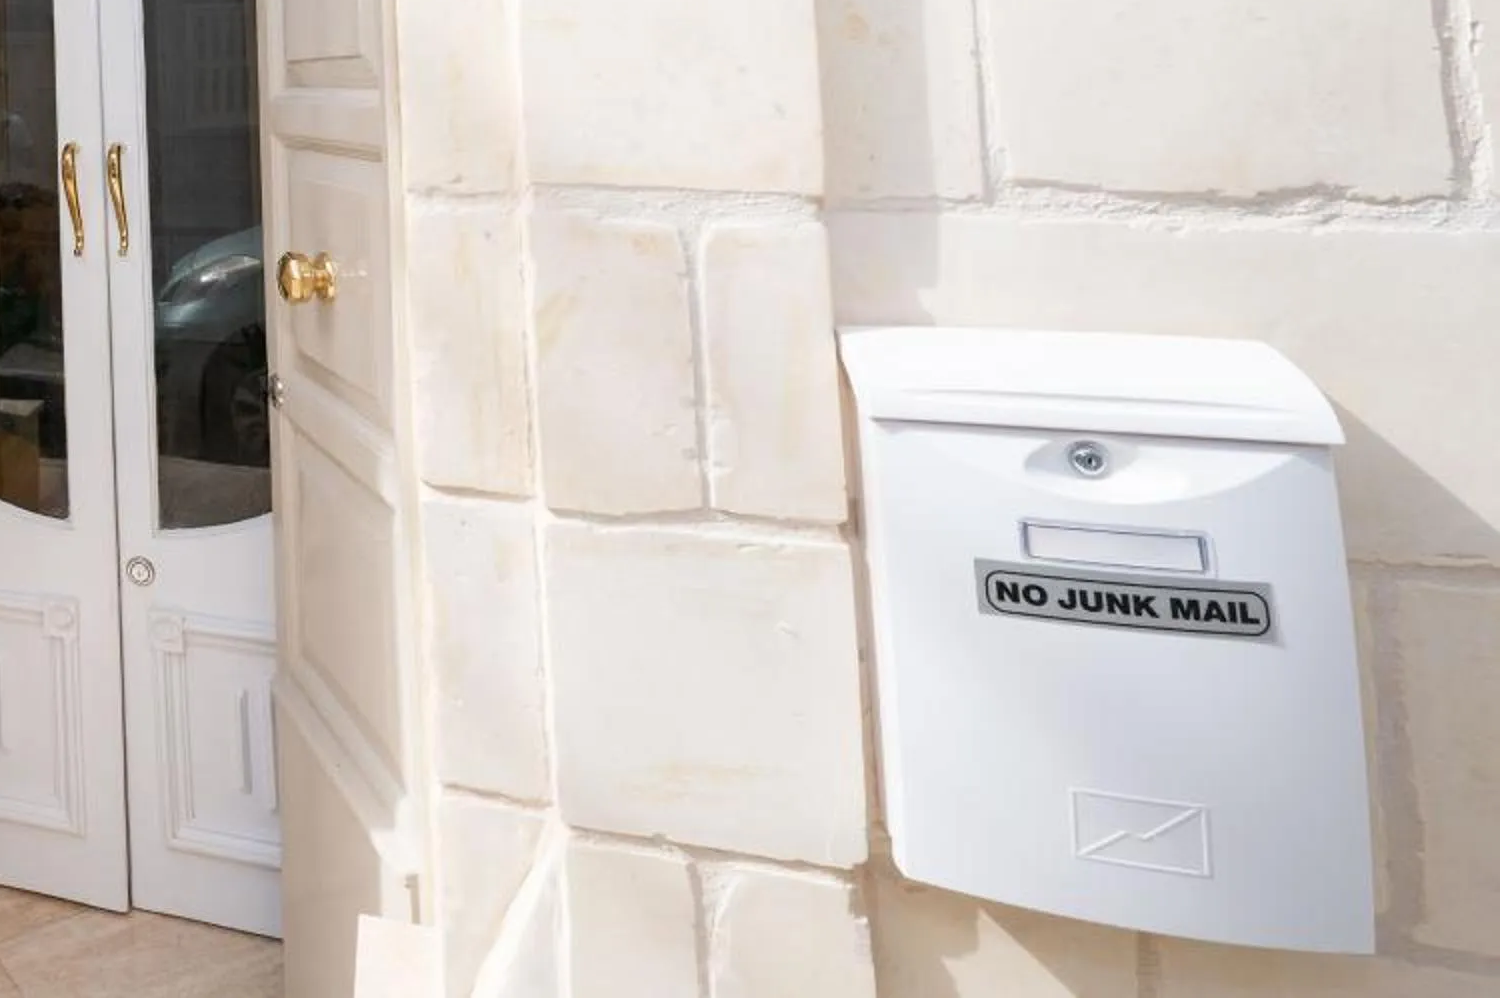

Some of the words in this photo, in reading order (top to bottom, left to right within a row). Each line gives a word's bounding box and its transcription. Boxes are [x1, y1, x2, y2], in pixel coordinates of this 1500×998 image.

[994, 580, 1049, 608] NO
[1057, 588, 1161, 620] JUNK
[1169, 596, 1262, 626] MAIL
